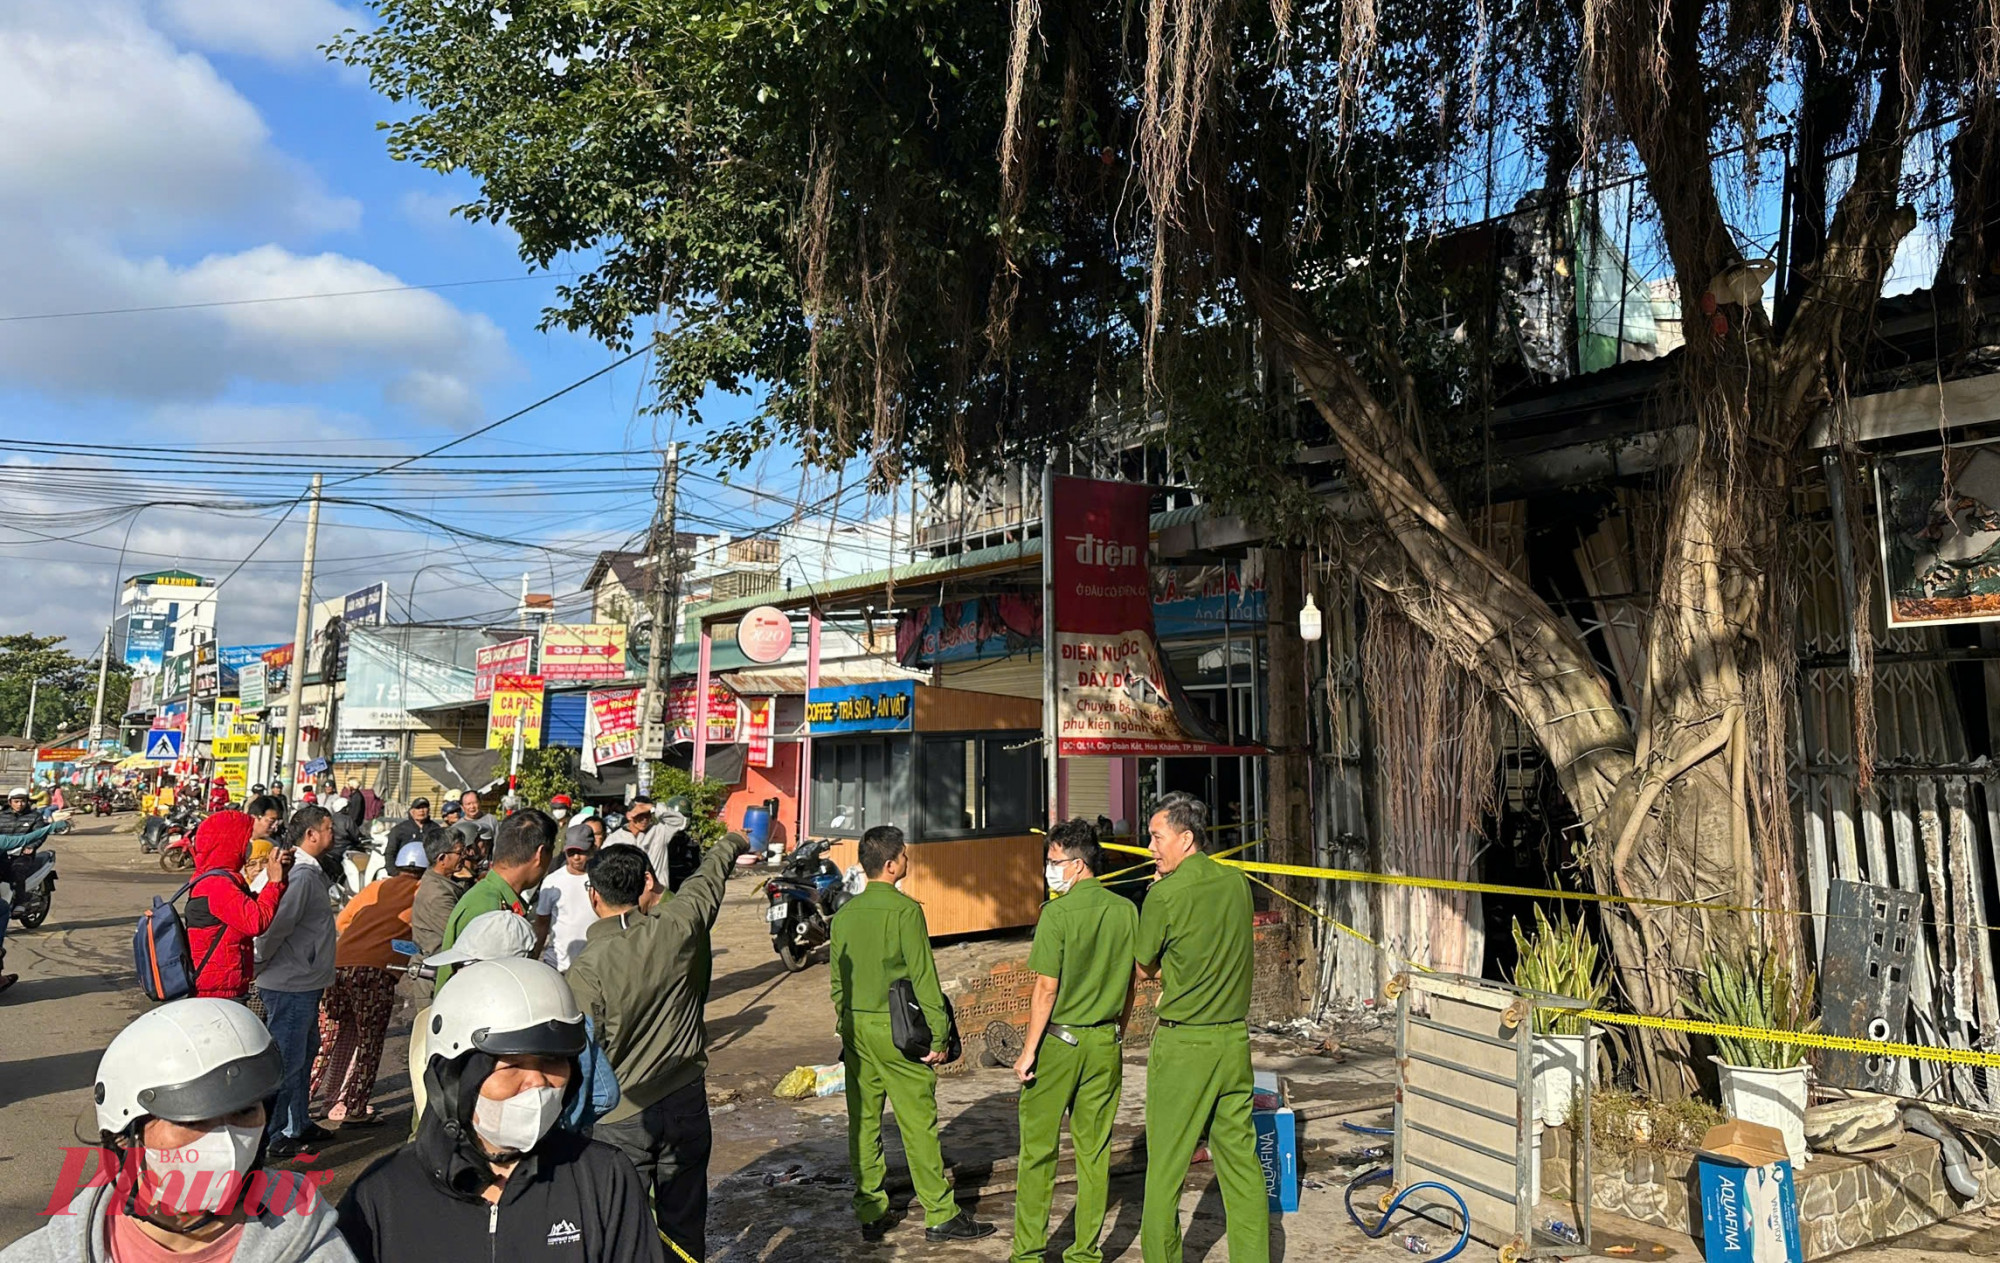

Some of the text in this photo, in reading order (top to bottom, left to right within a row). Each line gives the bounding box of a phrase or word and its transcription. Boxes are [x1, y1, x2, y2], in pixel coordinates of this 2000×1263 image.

[1065, 533, 1137, 572] điện
[157, 577, 198, 587] MAXHOME
[554, 646, 583, 654] 300
[1061, 639, 1139, 666] ĐIỆN NƯỚC
[1078, 665, 1108, 687] ĐẦY
[501, 695, 514, 710] CÀ
[807, 702, 834, 721] COFFEE
[838, 696, 853, 719] TRÀ
[854, 696, 871, 719] SỮA
[1076, 699, 1116, 713] Chuyên
[1119, 699, 1138, 716] bán
[233, 723, 248, 734] THU
[1063, 718, 1085, 733] phụ
[1087, 717, 1111, 733] kiện
[1113, 720, 1148, 734] ngành
[219, 742, 248, 754] THU MUA
[1097, 741, 1112, 752] Chợ
[1259, 1130, 1277, 1198] AQUAFINA
[1718, 1175, 1741, 1252] AQUAFINA
